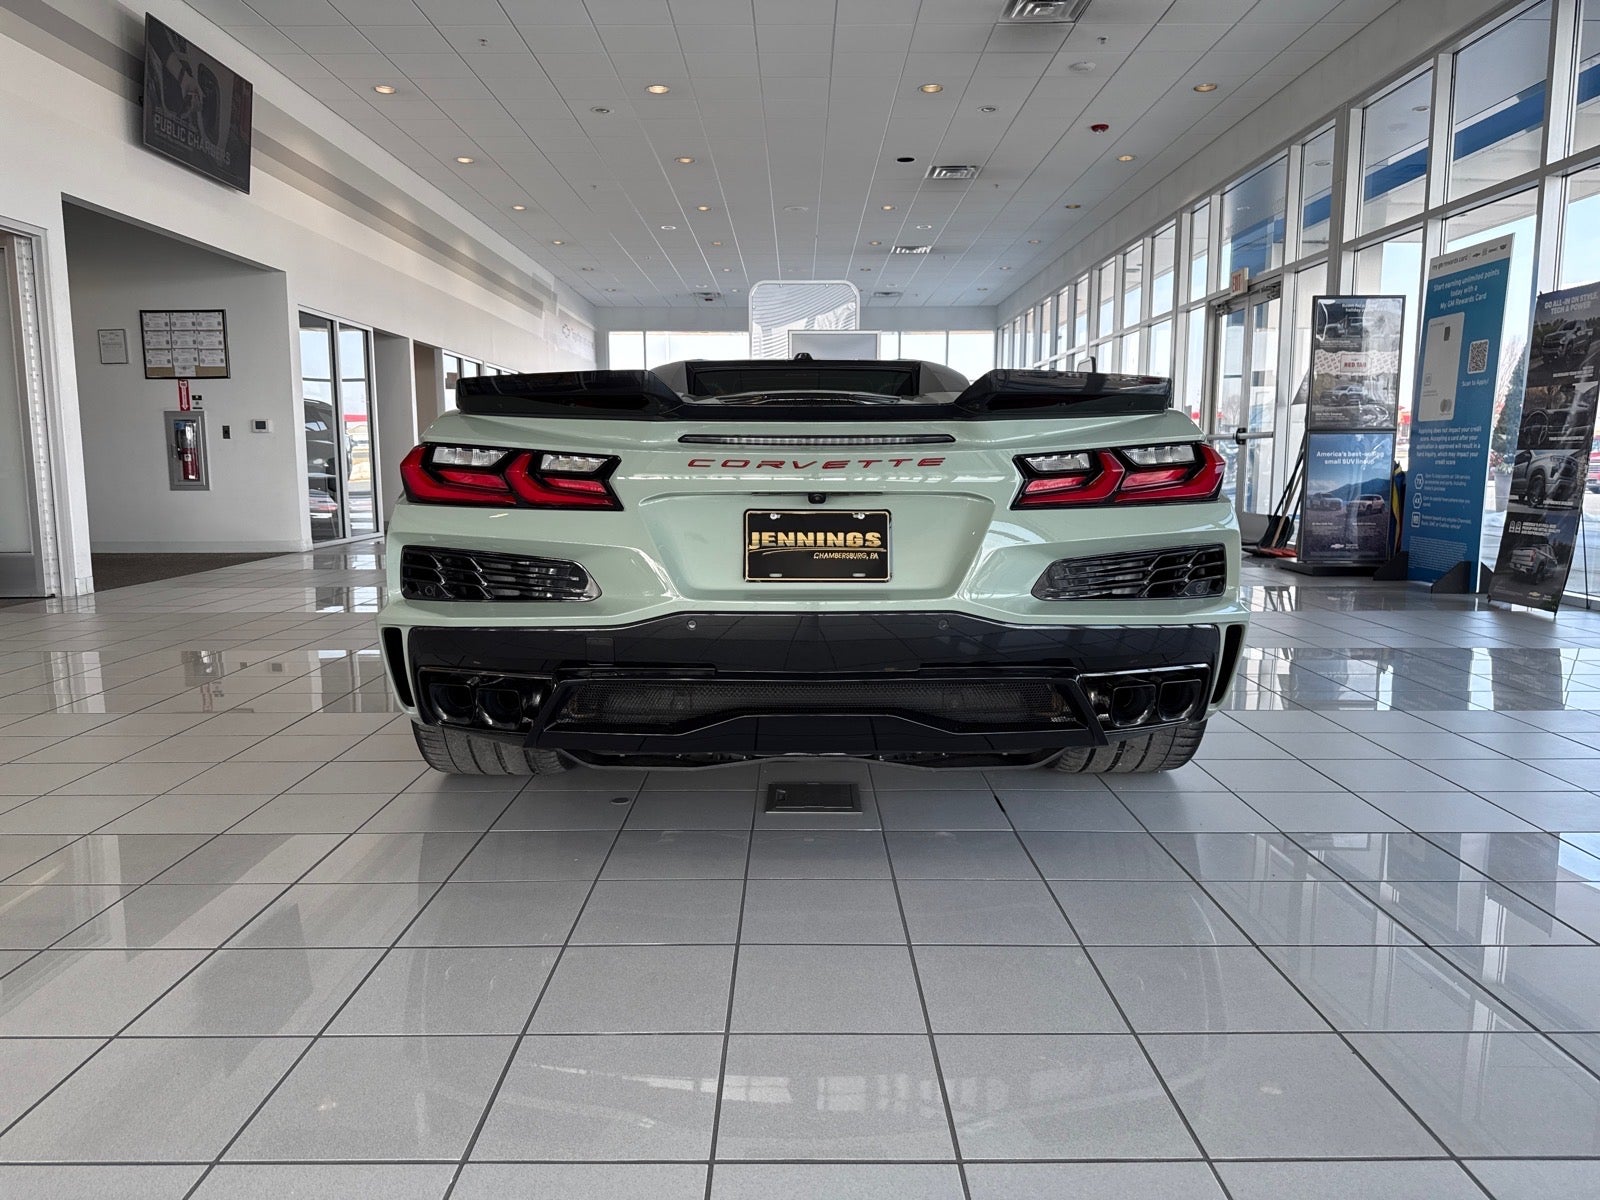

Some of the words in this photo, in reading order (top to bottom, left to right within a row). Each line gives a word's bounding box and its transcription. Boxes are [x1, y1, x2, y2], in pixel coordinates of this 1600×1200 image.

[154, 114, 187, 142] PUBLIC
[1232, 273, 1241, 292] EXIT
[1433, 282, 1445, 292] Start
[1445, 279, 1461, 289] earning
[1462, 273, 1484, 284] unlimited
[1484, 269, 1500, 280] points
[1439, 303, 1447, 311] My
[1455, 296, 1475, 305] Rewards
[1475, 292, 1488, 301] Card
[1451, 289, 1463, 298] today
[1544, 301, 1552, 309] GO
[1553, 297, 1571, 307] ALL-IN
[1571, 296, 1580, 304] ON
[1551, 305, 1565, 315] TECH
[1570, 300, 1591, 312] POWER
[687, 457, 946, 470] CORVETTE
[748, 531, 882, 550] JENNINGS
[813, 551, 868, 560] CHAMBERSBURG,
[869, 552, 879, 560] PA
